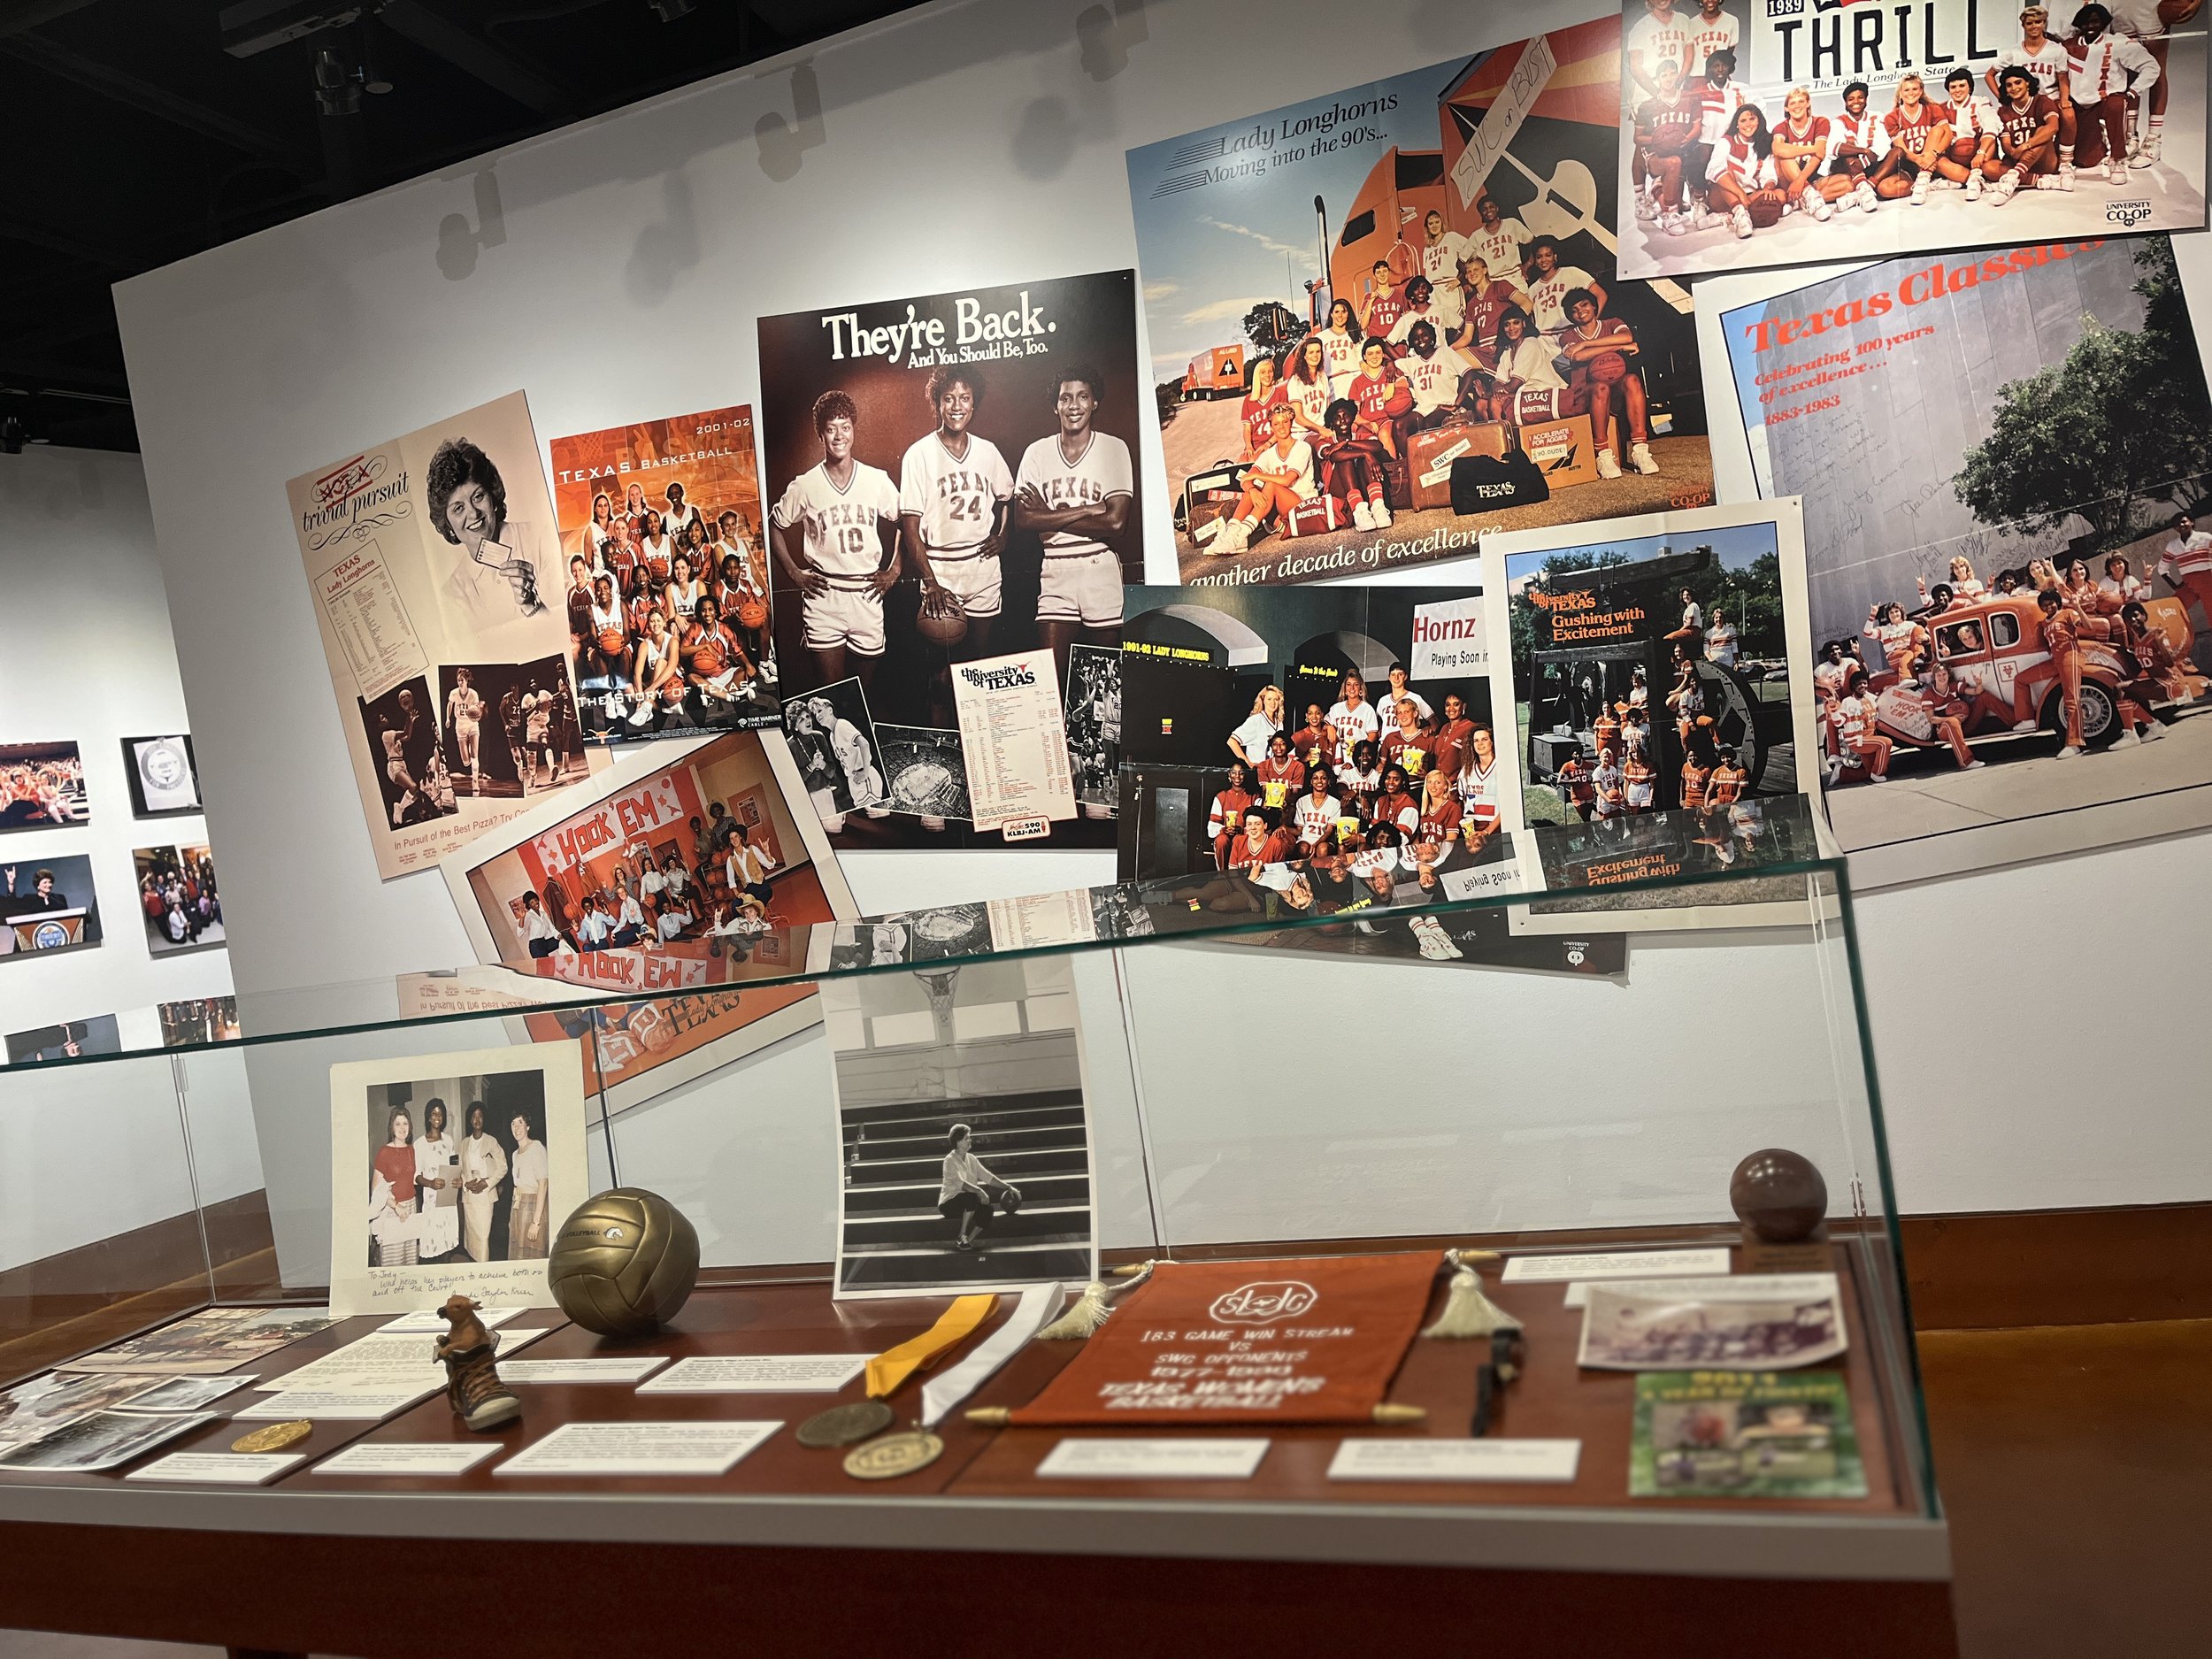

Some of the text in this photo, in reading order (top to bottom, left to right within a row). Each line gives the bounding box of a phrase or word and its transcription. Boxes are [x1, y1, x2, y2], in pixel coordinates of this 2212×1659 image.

[1768, 0, 1803, 17] 1989
[1774, 0, 1998, 82] THRILL
[1813, 80, 1832, 89] The
[1219, 93, 1398, 157] Lady Longhorns
[1652, 111, 1691, 127] TEXAS
[1205, 158, 1267, 185] Moving
[1271, 147, 1306, 167] into
[1310, 136, 1338, 157] the
[2106, 201, 2151, 211] UNIVERSITY
[2106, 209, 2152, 221] CO-OP
[1372, 301, 1401, 316] TEXAS
[821, 290, 1056, 364] They're Back.
[1379, 312, 1394, 326] 10
[1746, 289, 1893, 354] Texas
[907, 338, 1048, 369] And You Should Be, Too.
[1755, 325, 1935, 387] Celebrating 100 years
[1523, 392, 1549, 403] TEXAS
[1758, 384, 1777, 403] of
[1521, 404, 1551, 414] BASKETBALL
[1765, 395, 1841, 426] 1883-1983
[696, 418, 750, 434] 2001-02
[1433, 453, 1450, 468] SWC
[303, 491, 349, 533] trivial
[352, 471, 410, 524] pursuit
[950, 495, 982, 521] 24
[1297, 497, 1322, 510] TEXAS
[1296, 509, 1325, 519] BASKETBALL
[838, 528, 864, 555] 10
[333, 554, 362, 578] TEXAS
[1189, 563, 1271, 587] another
[1278, 545, 1356, 576] decade
[1361, 539, 1386, 567] of
[326, 558, 375, 594] Lady Longhorns
[1550, 597, 1596, 611] TEXAS
[1551, 607, 1645, 627] Gushing with
[1413, 617, 1476, 643] Hornz
[1553, 622, 1634, 641] Excitement
[1152, 645, 1171, 657] LADY
[1171, 648, 1210, 661] LONGHORNS
[1431, 650, 1479, 668] Playing Soon
[973, 672, 1036, 691] of TEXAS
[1896, 702, 1919, 714] HOOK
[762, 714, 782, 723] WARNER
[394, 841, 401, 850] In
[403, 835, 428, 849] Pursuit
[430, 832, 438, 841] of
[440, 828, 451, 840] the
[454, 823, 471, 834] Best
[472, 815, 497, 831] Pizza?
[557, 812, 617, 866] HOOK
[368, 1271, 378, 1279] To
[399, 1277, 418, 1287] helps
[438, 1274, 465, 1286] players
[468, 1271, 476, 1280] to
[512, 1268, 530, 1277] both
[373, 1286, 389, 1297] and
[394, 1286, 405, 1294] off
[1141, 1326, 1355, 1342] 183 GAME WIN STREAK
[1229, 1340, 1251, 1352] VS
[1204, 1351, 1308, 1365] OPPONENTS
